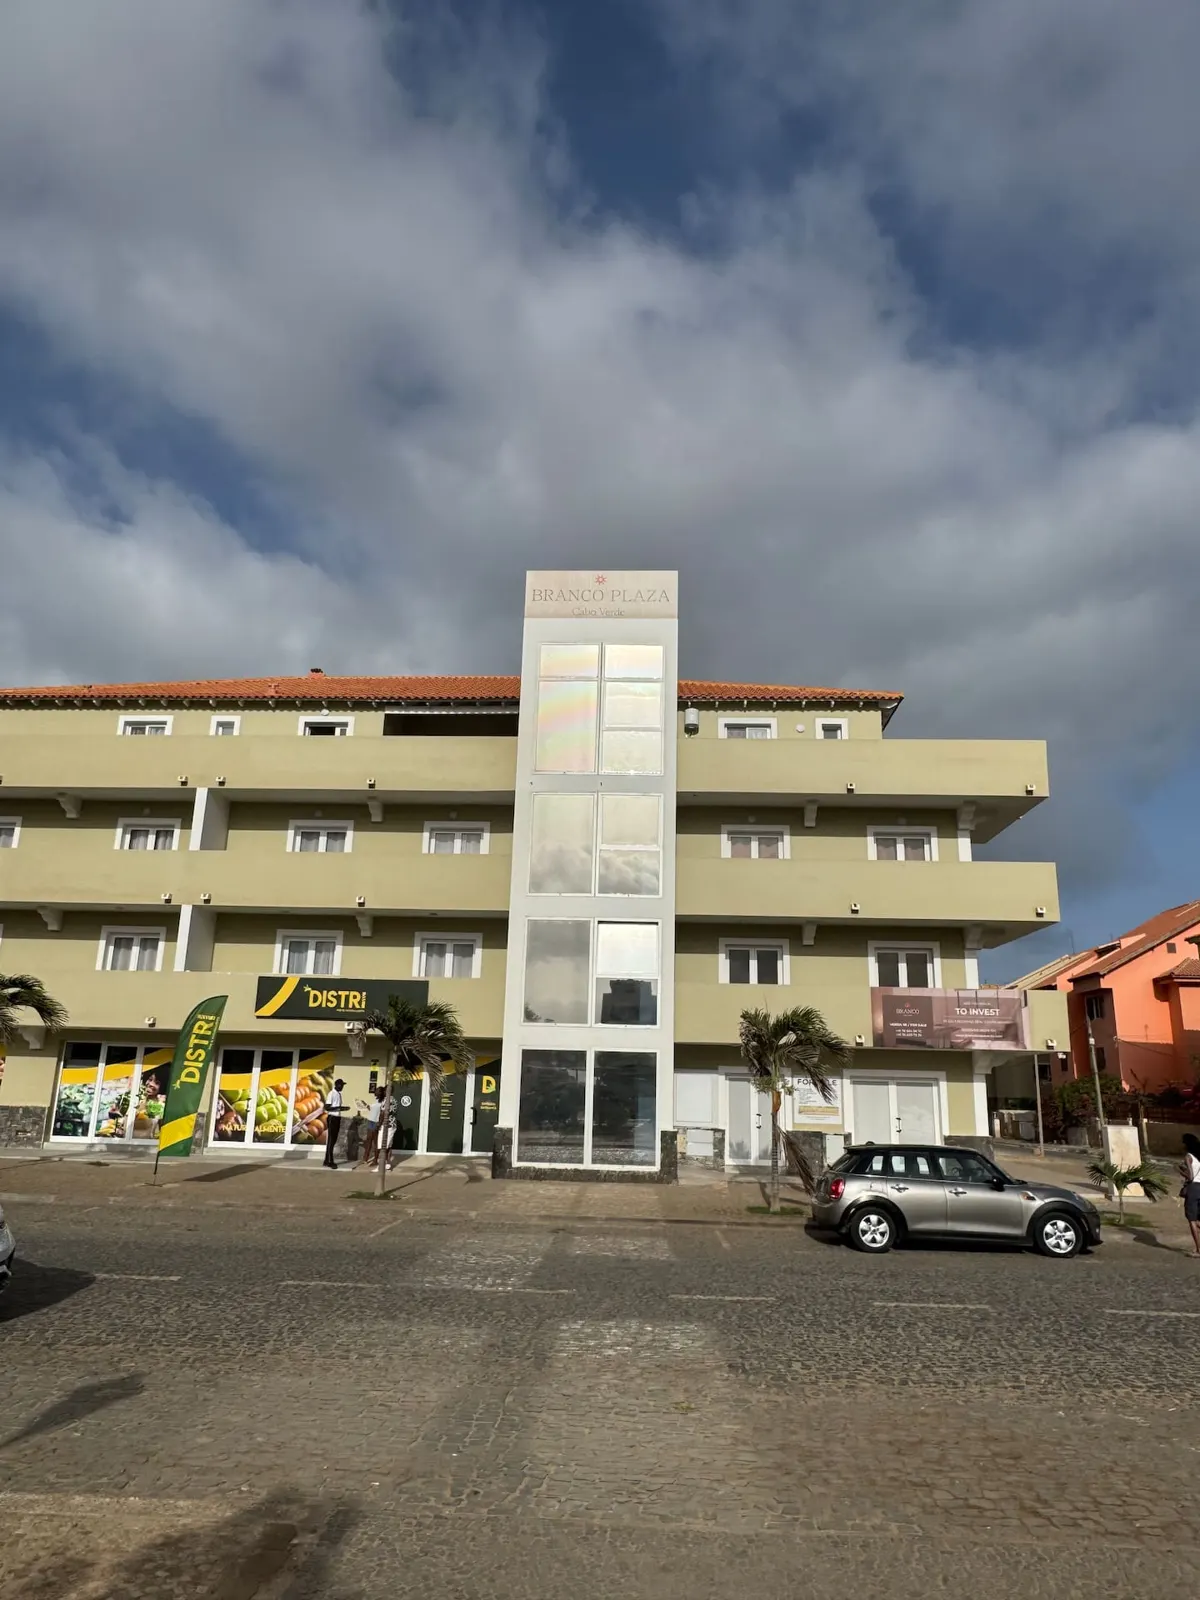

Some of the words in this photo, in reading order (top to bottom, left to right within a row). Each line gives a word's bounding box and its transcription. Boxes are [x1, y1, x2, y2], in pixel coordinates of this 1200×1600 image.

[532, 589, 604, 602] BRANCO
[611, 589, 671, 602] PLAZA
[572, 608, 597, 616] Cabo
[600, 608, 625, 616] Verde
[955, 1008, 968, 1016] TO
[969, 1008, 1000, 1016] INVEST
